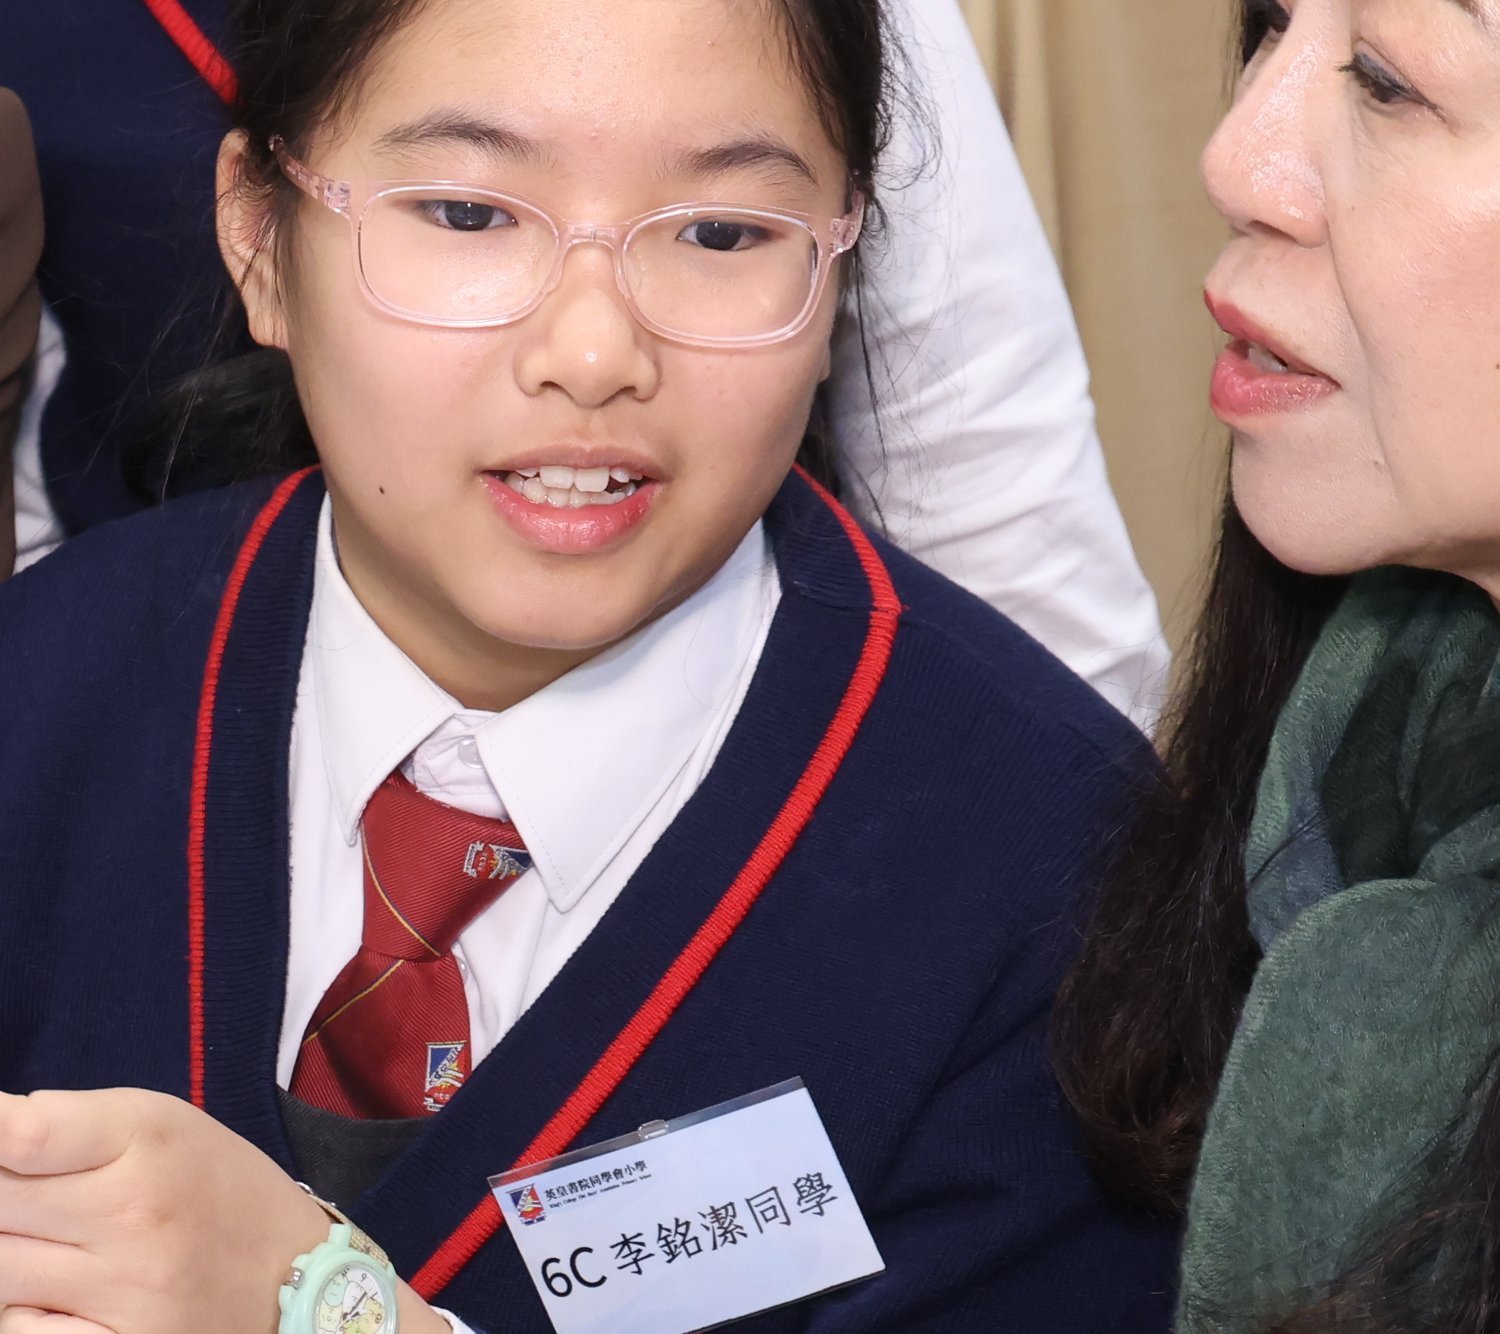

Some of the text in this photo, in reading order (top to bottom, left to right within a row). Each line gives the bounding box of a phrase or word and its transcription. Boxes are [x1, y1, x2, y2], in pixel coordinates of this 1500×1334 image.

[544, 1160, 648, 1201] 英皇書院同學會小學
[541, 1171, 839, 1299] 6C 李銘潔同學
